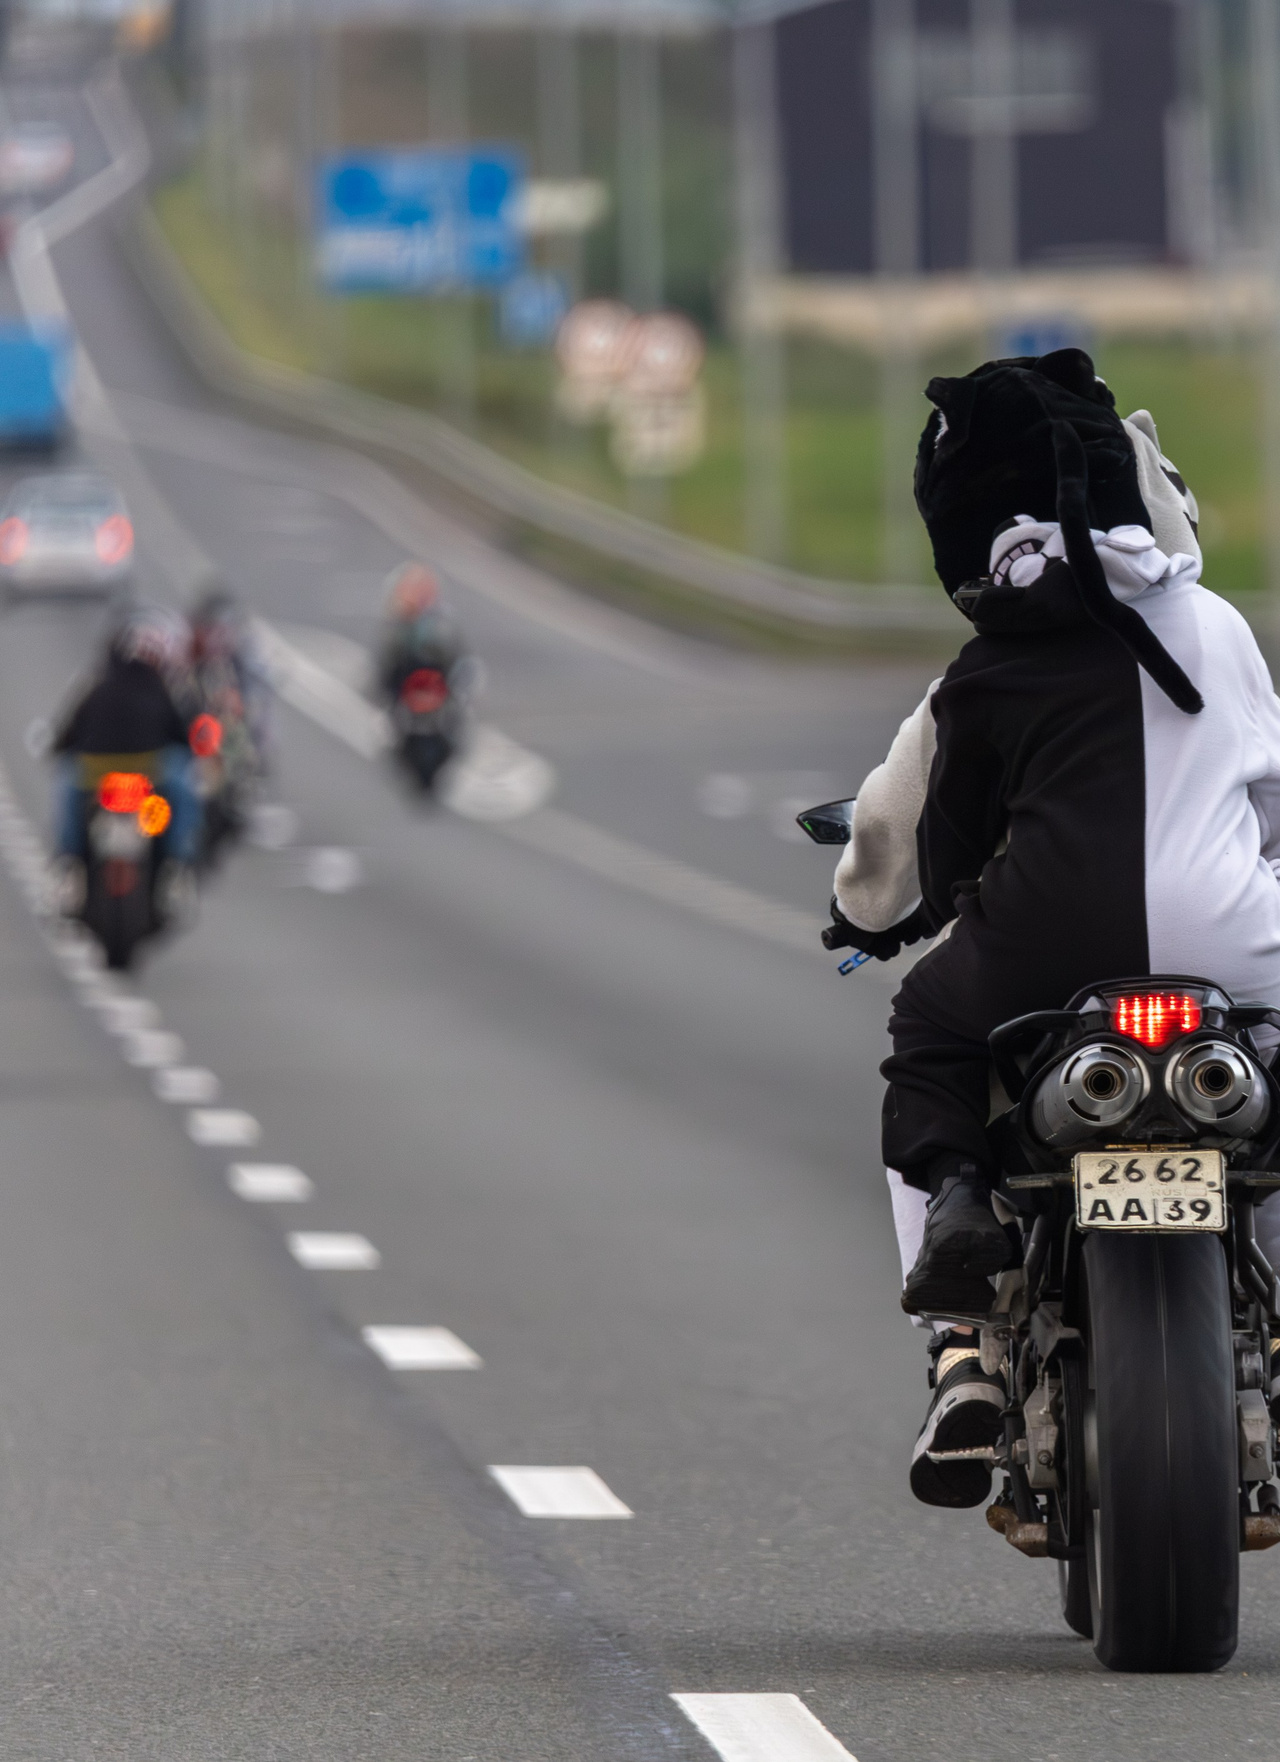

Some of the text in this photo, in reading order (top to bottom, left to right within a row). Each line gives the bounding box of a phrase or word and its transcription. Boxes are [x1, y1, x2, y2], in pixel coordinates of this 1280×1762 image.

[1097, 1157, 1204, 1185] 2662
[1151, 1187, 1182, 1197] RUS
[1087, 1198, 1212, 1222] AA 39
